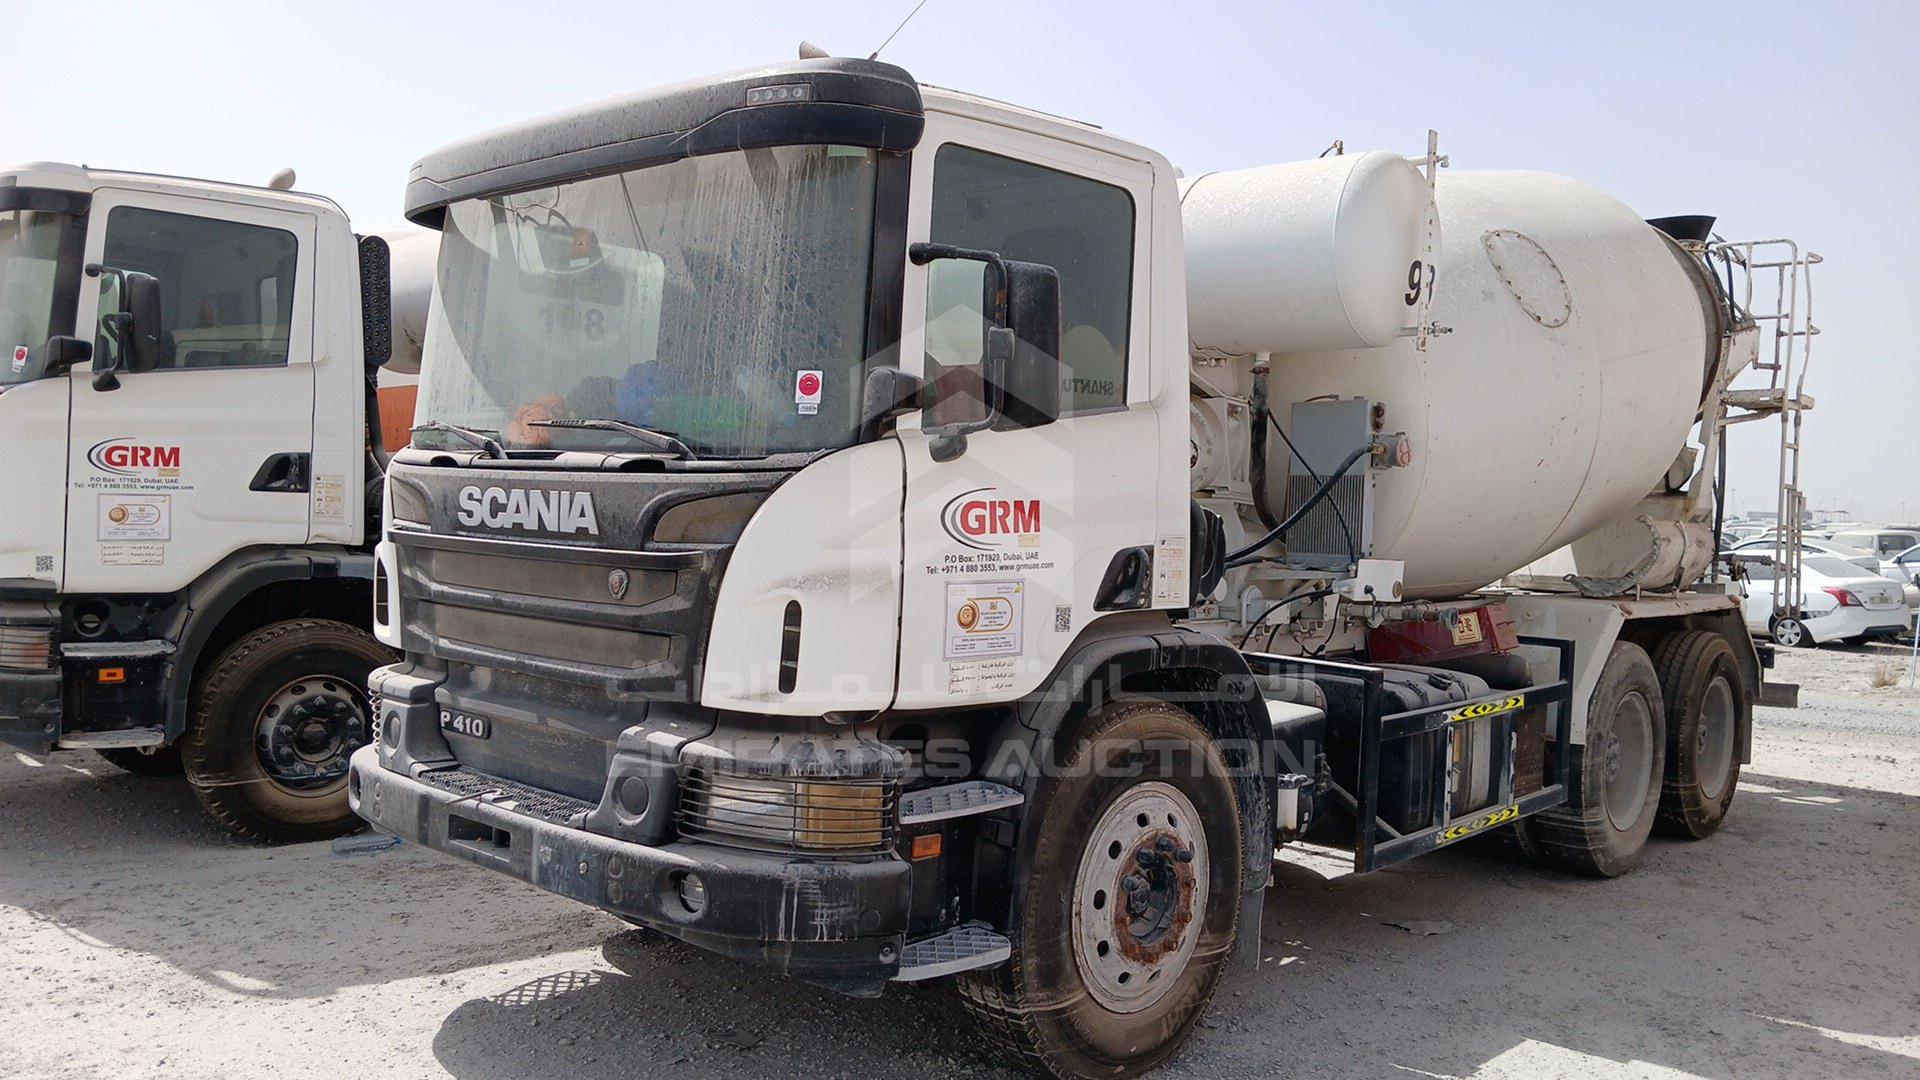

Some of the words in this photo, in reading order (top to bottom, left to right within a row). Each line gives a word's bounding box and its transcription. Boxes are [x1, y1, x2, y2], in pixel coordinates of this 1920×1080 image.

[105, 445, 180, 468] GRM
[457, 485, 599, 536] SCANIA
[960, 499, 1041, 536] GRM
[1025, 551, 1039, 560] UAE
[925, 565, 939, 575] Tel:
[941, 564, 958, 574] +971
[960, 564, 965, 573] 4
[965, 564, 979, 573] 880
[440, 711, 451, 727] P
[453, 715, 484, 737] 410
